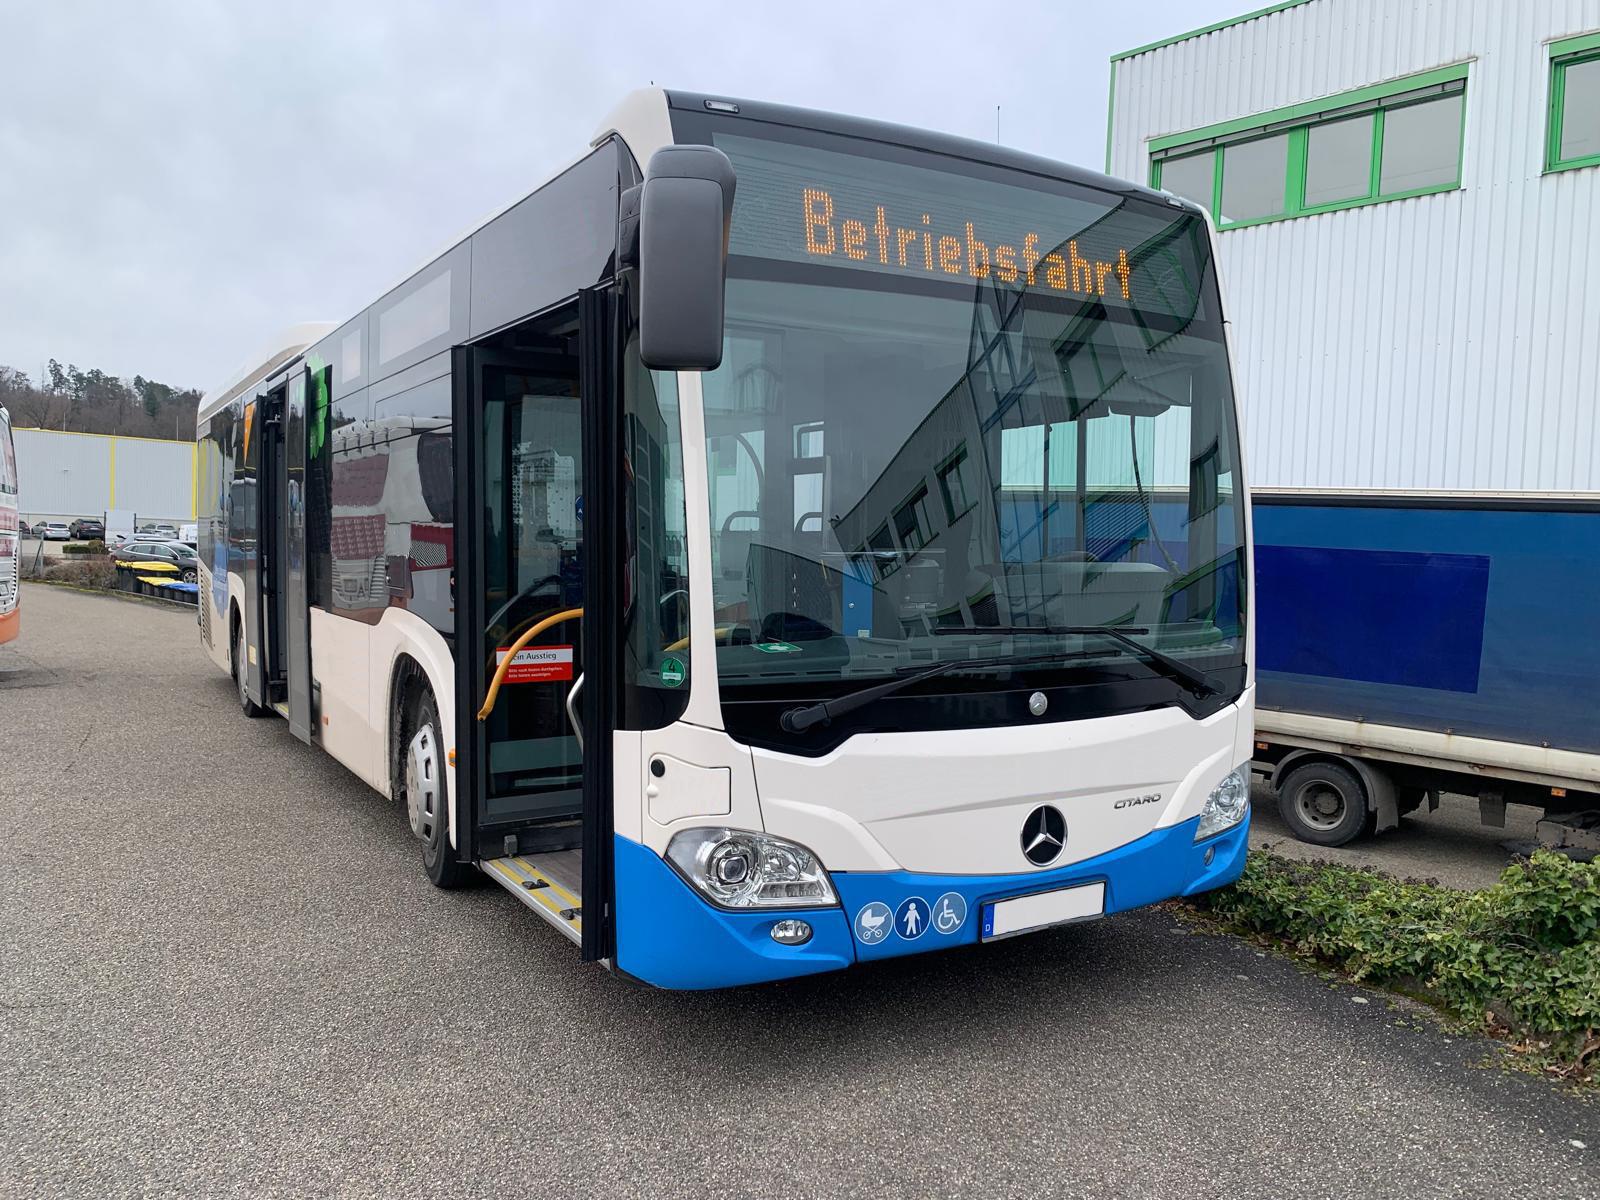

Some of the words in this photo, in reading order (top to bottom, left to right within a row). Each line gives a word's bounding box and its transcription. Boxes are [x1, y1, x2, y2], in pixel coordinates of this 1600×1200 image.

[803, 188, 1131, 300] Betriebsfahrt
[526, 652, 557, 660] Ausstieg
[1114, 793, 1162, 809] CITARO
[985, 924, 990, 932] D
